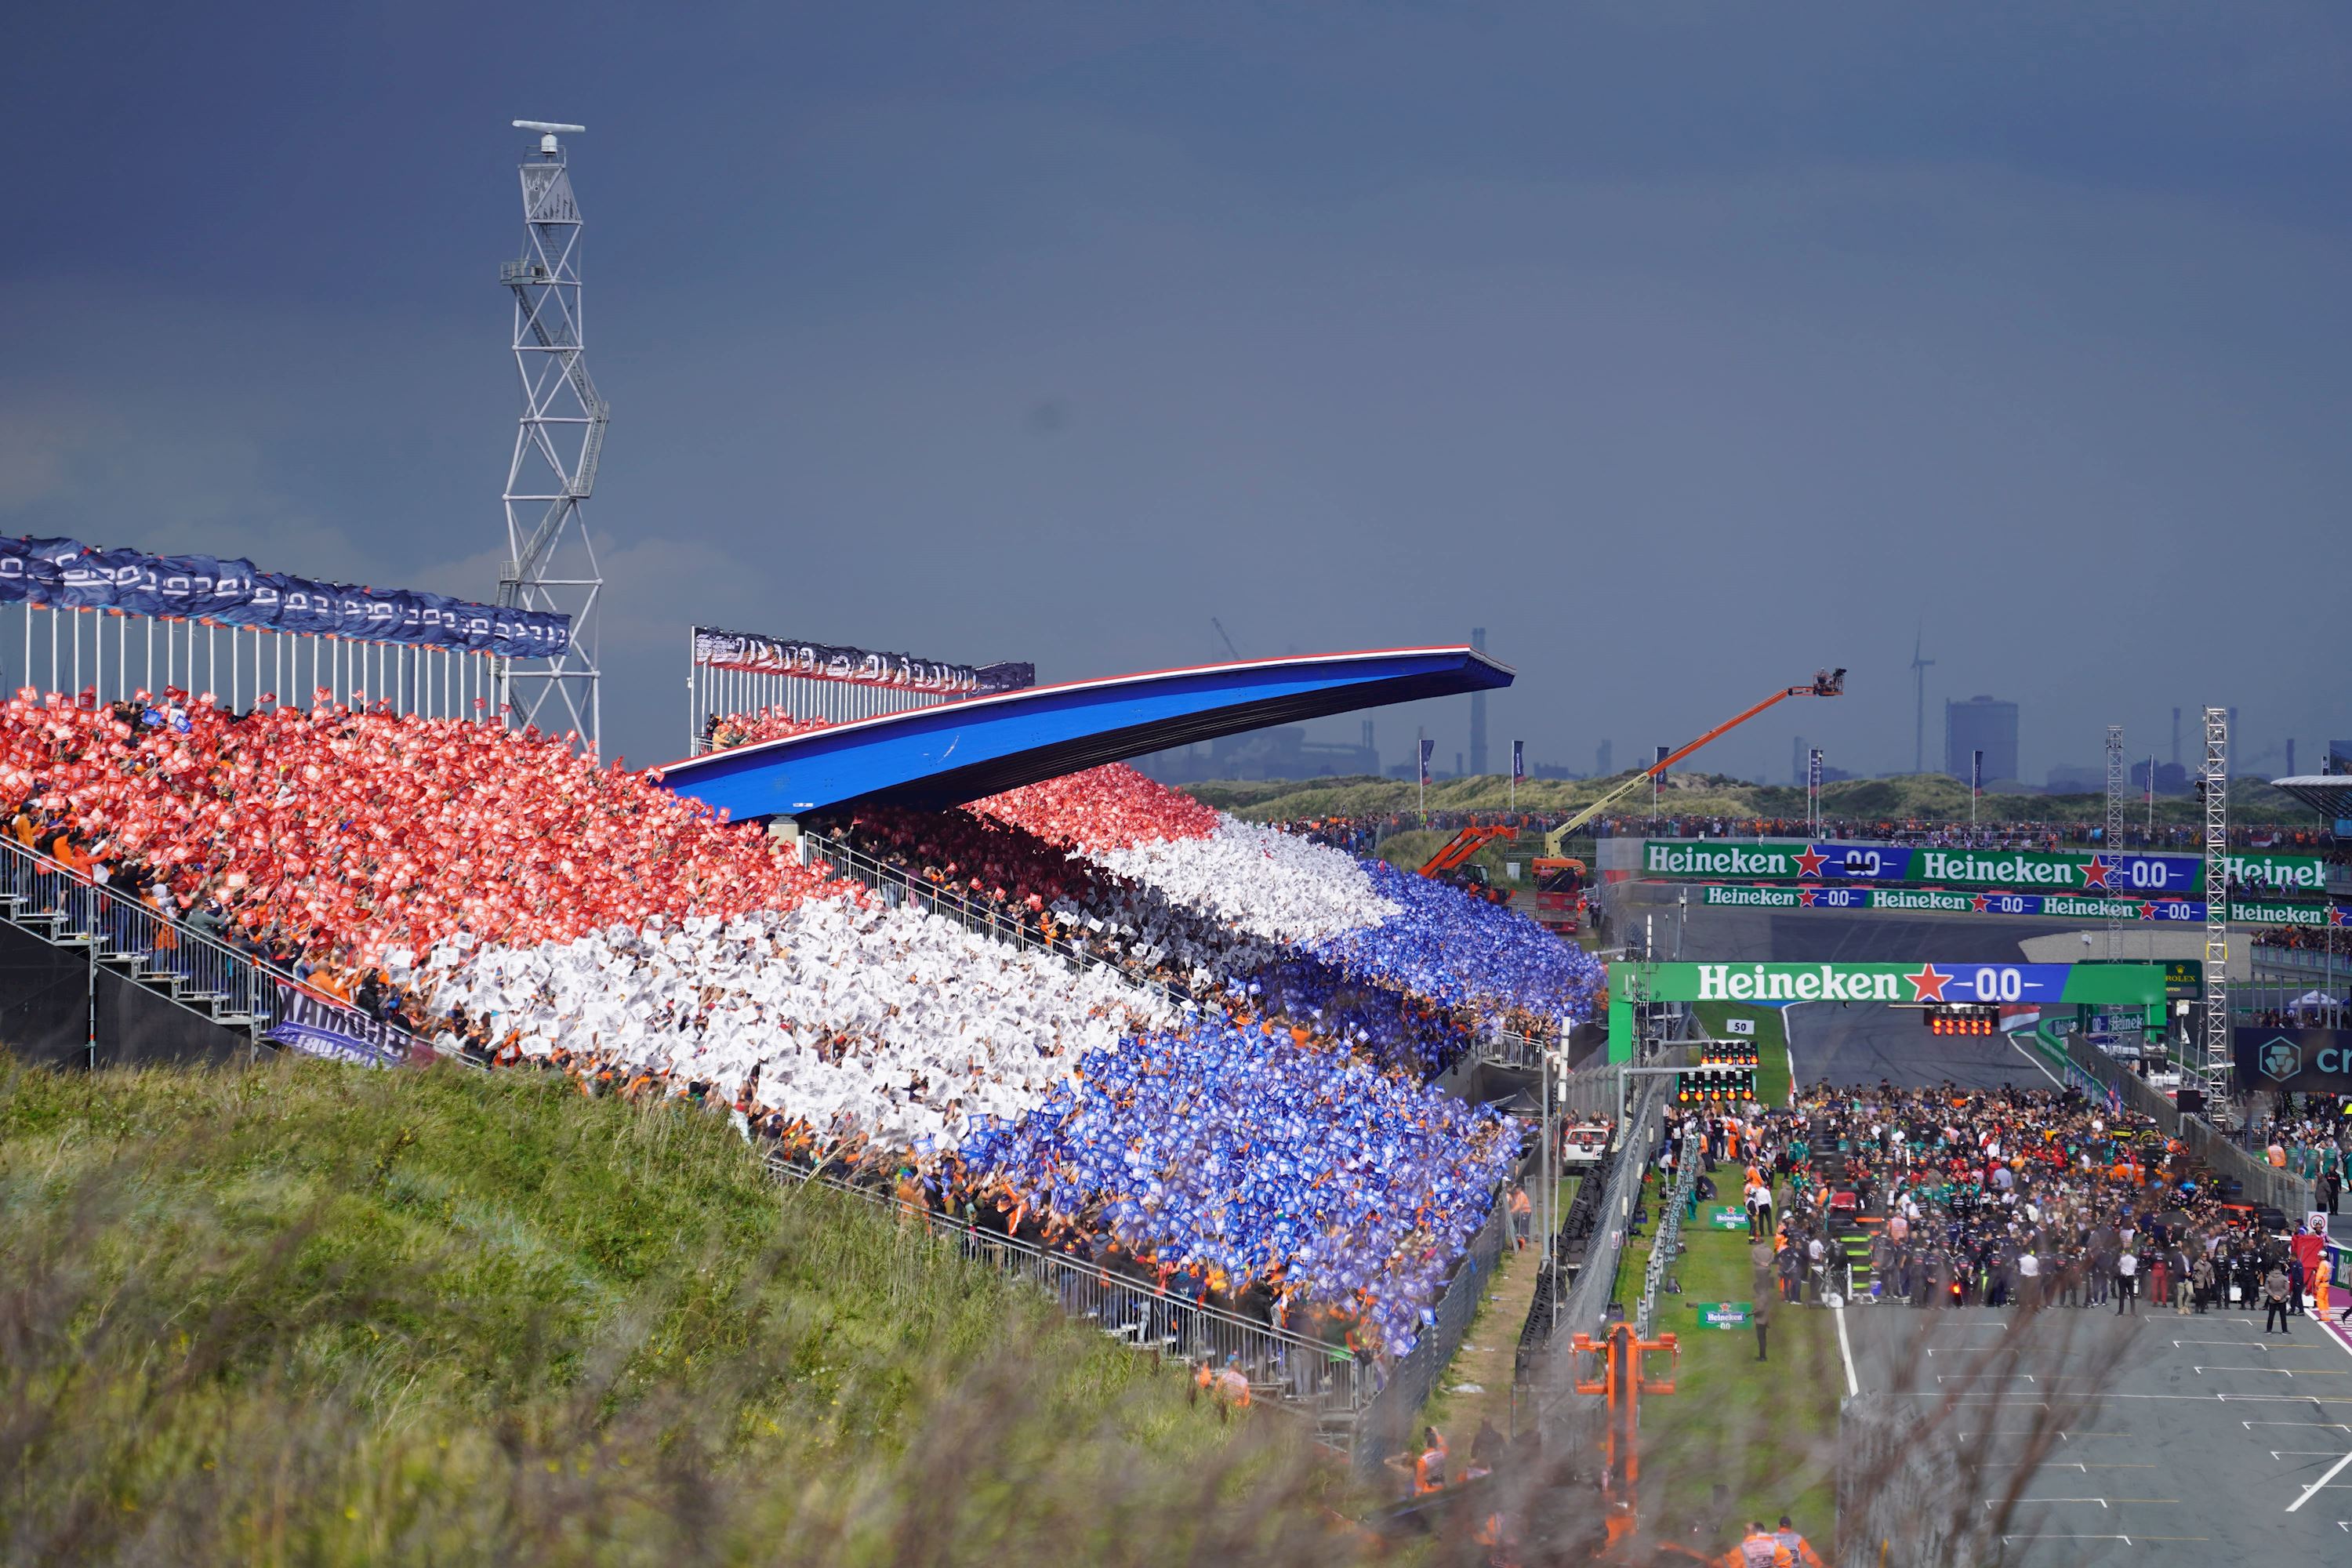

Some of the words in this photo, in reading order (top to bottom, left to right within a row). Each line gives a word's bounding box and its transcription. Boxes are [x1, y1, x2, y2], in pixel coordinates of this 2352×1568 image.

[1647, 845, 1787, 875] Heineken
[1923, 852, 2072, 884] Heineken
[2132, 861, 2167, 888] 0.0
[1708, 887, 1795, 907] Heineken
[1828, 890, 1849, 907] 0.0
[1872, 890, 1965, 910] Heineken
[2001, 897, 2023, 913] 0.0
[2044, 897, 2134, 917] Heineken
[2168, 903, 2190, 921] 0.0
[2231, 903, 2321, 924] Heineken
[1698, 964, 1900, 1000] Heineken
[1976, 967, 2021, 1002] 0.0
[1734, 1022, 1746, 1032] 50
[1664, 1245, 1676, 1254] 40
[1707, 1312, 1744, 1321] Heineken
